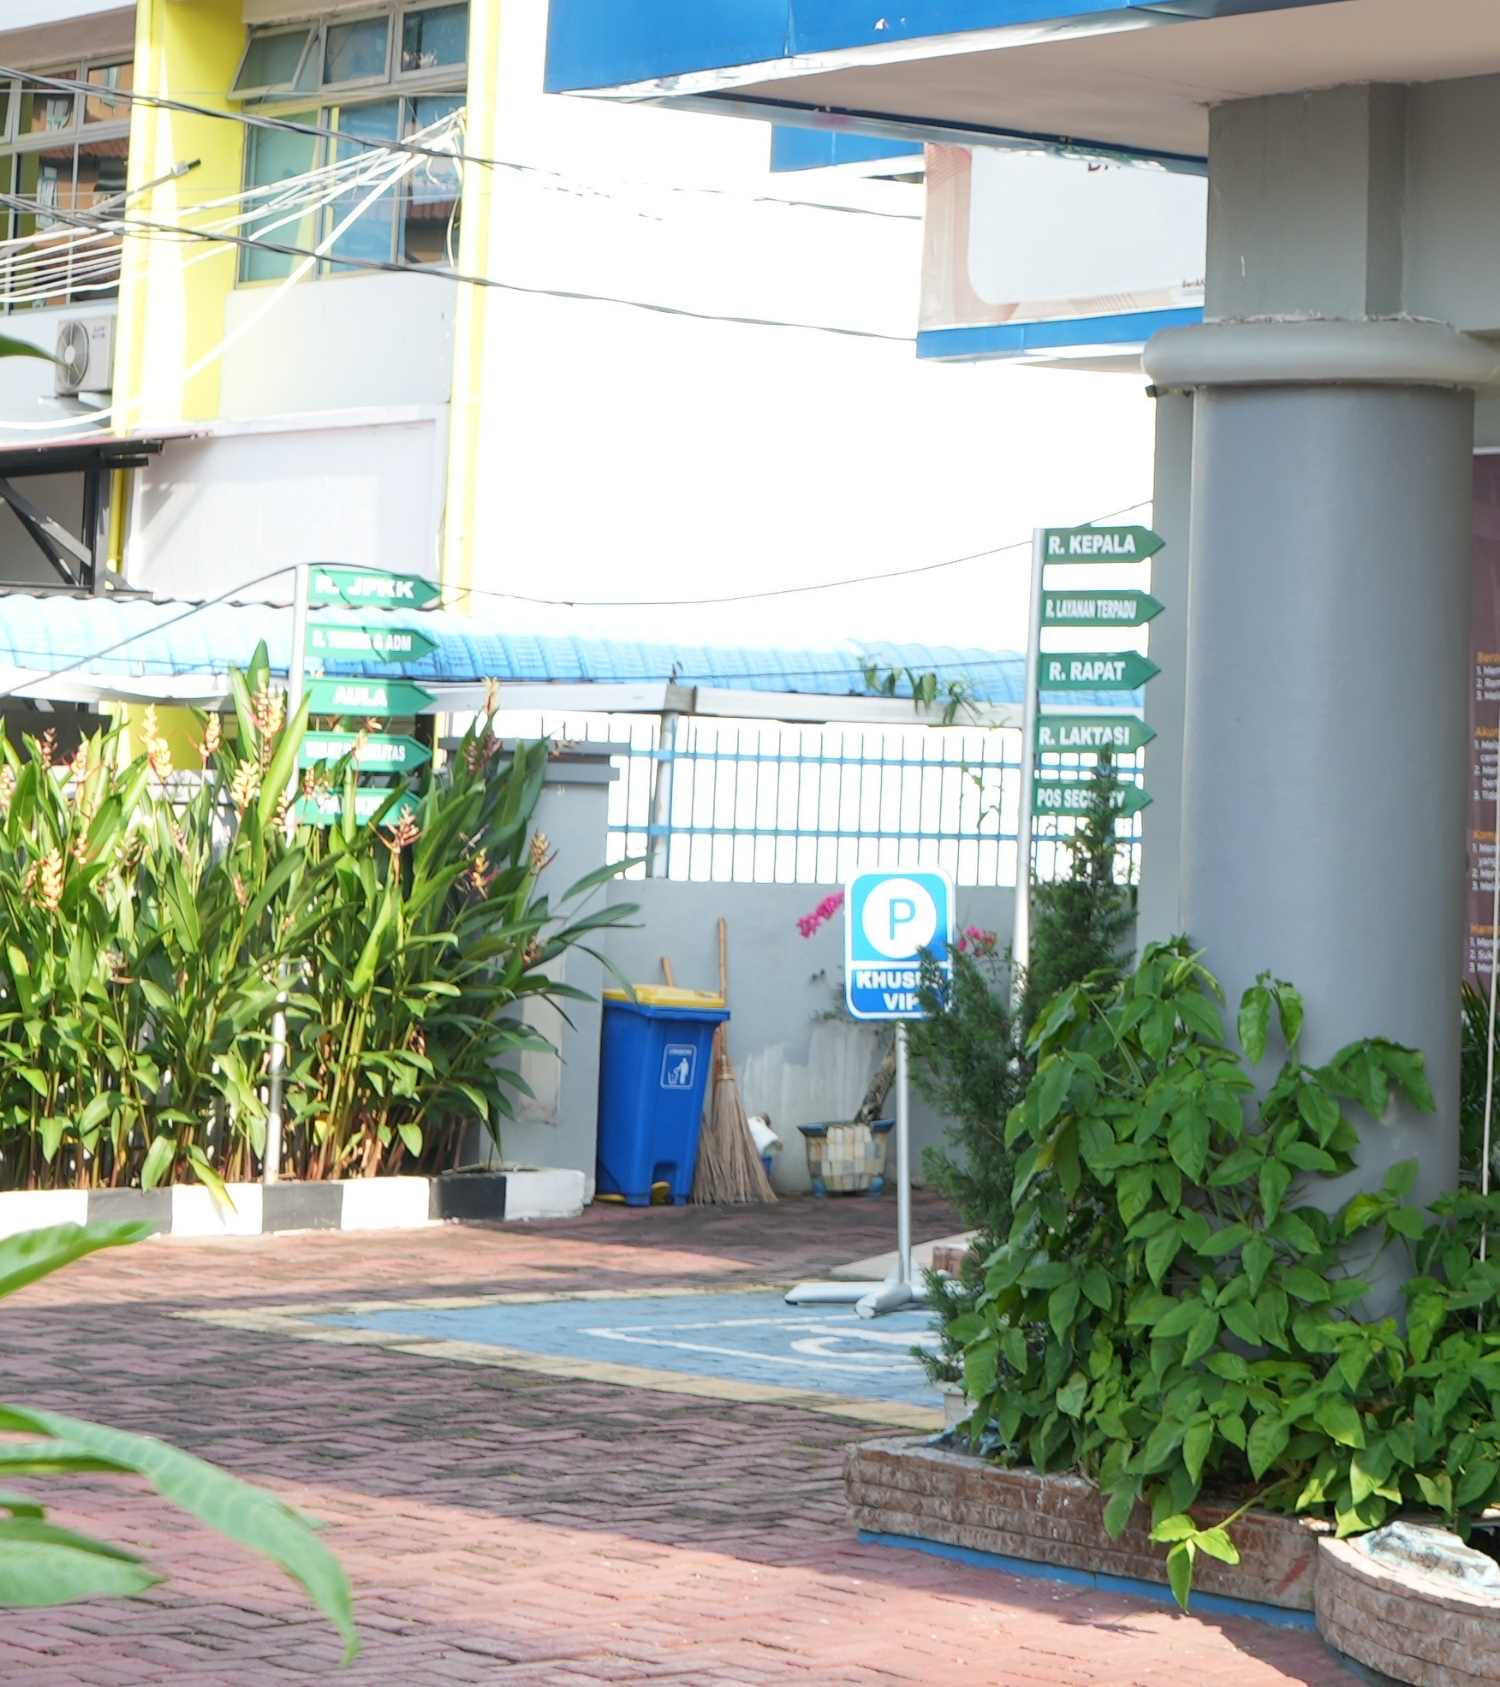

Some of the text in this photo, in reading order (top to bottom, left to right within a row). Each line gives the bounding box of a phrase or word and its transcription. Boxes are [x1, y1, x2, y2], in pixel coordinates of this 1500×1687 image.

[1048, 534, 1136, 555] R. KEPALA
[1056, 599, 1096, 618] LAYANAN
[1097, 600, 1137, 619] TERPADU
[1049, 661, 1126, 681] R. RAPAT
[332, 685, 388, 707] AULA
[1039, 726, 1130, 746] R. LAKTASI
[1037, 788, 1061, 808] POS
[889, 898, 916, 940] P
